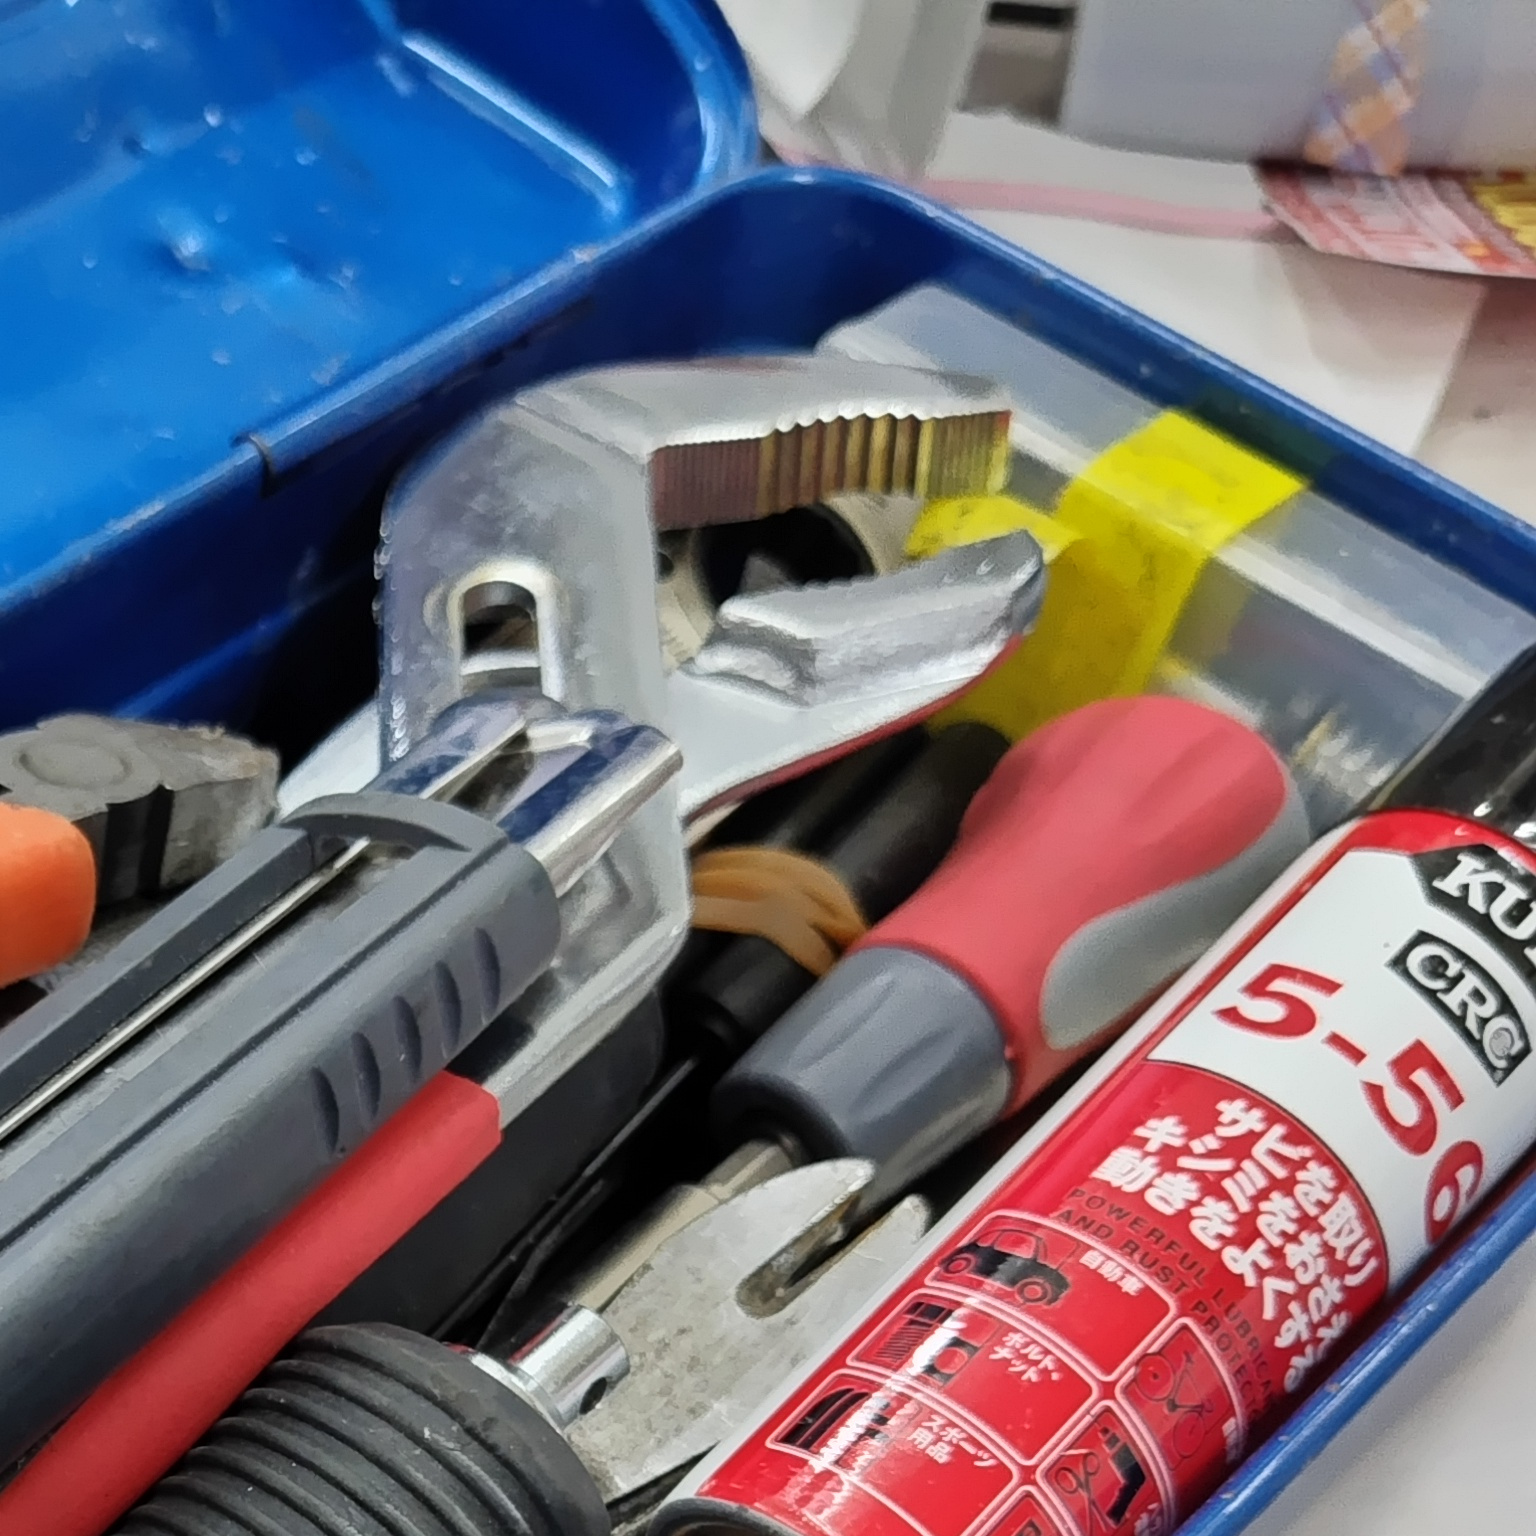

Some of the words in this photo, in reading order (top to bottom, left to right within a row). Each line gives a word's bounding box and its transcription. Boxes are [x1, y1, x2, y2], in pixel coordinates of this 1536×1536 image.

[1432, 853, 1536, 972] KU
[1405, 941, 1522, 1068] CRC
[1211, 962, 1485, 1244] 5-56
[1066, 1188, 1208, 1287] POWERFUL
[1214, 1098, 1379, 1287] サビを取り
[1055, 1209, 1114, 1240] AND
[1121, 1238, 1191, 1295] RUST
[1078, 1248, 1146, 1297] 自動車
[906, 1426, 955, 1465] 用品
[920, 1414, 1000, 1468] スポーツ
